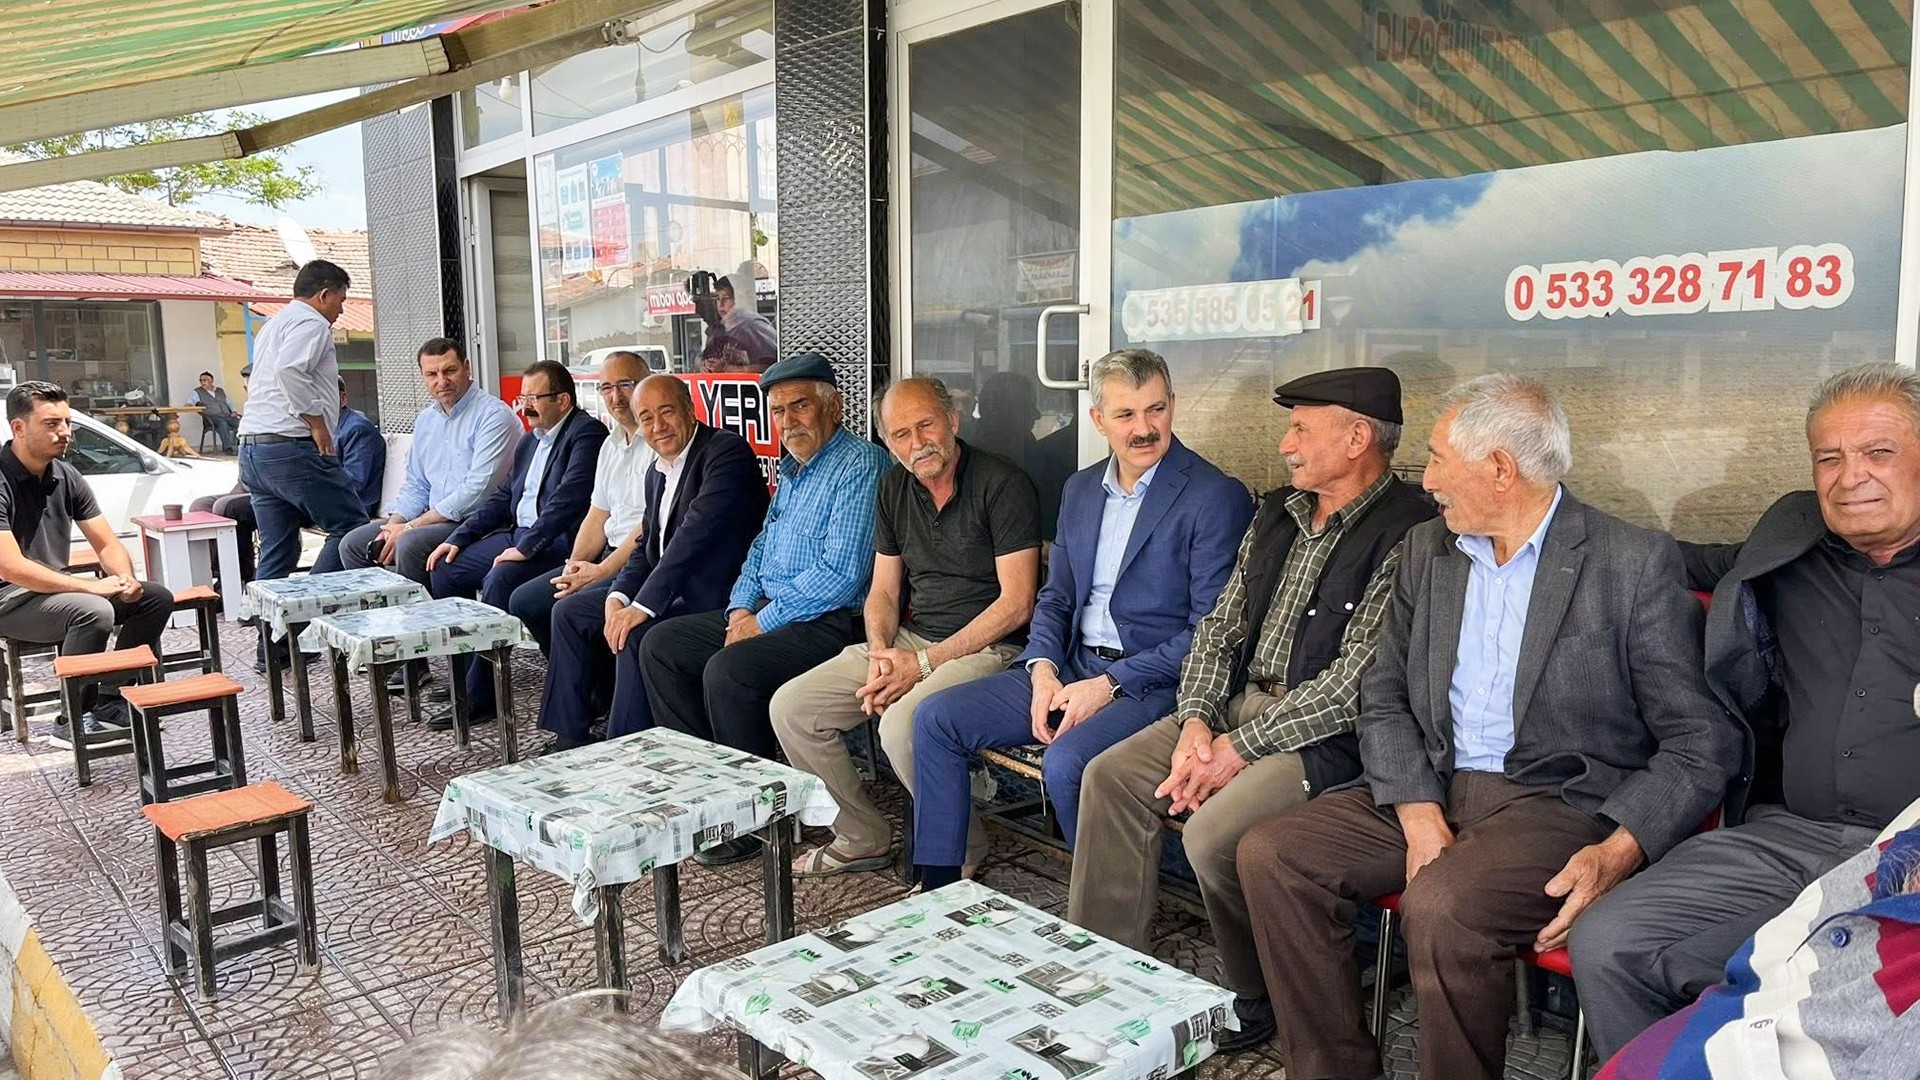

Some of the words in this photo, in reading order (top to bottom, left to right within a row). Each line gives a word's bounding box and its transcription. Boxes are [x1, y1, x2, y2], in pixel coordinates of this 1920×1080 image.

[1514, 275, 1534, 311] 0
[1546, 270, 1613, 309] 533
[1627, 264, 1701, 305] 328
[1718, 259, 1765, 300] 71
[1786, 255, 1842, 298] 83
